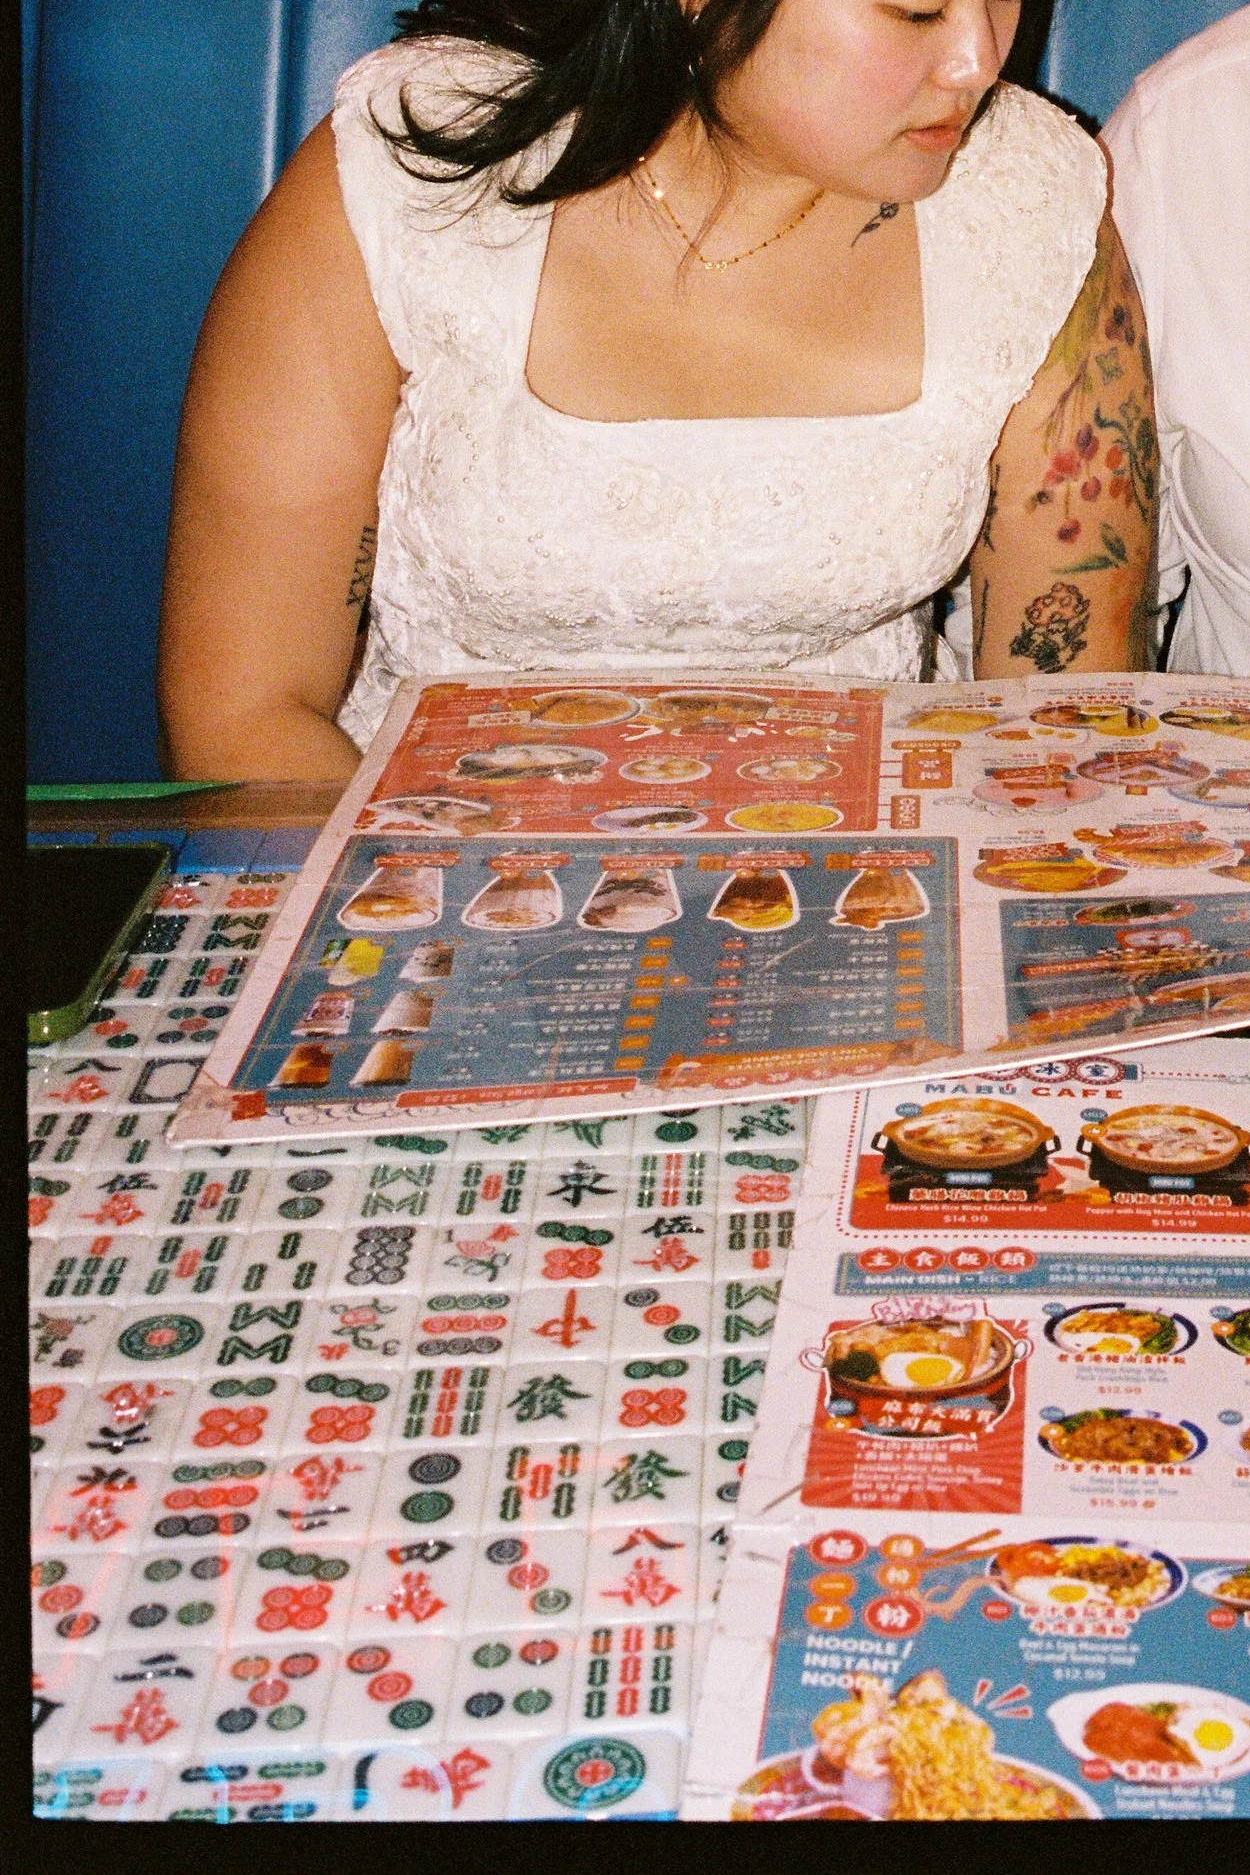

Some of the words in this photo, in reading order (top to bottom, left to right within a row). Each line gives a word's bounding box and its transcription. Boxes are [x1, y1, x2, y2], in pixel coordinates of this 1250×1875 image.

[1031, 1086, 1123, 1100] CAFE
[546, 1160, 617, 1208] 東
[944, 1214, 989, 1224] $14.99
[1151, 1218, 1198, 1228] $14.99
[864, 1274, 919, 1285] MAIN
[922, 1274, 961, 1285] DISH
[979, 1274, 1018, 1285] RICE
[806, 1634, 899, 1655] NOODLE
[803, 1651, 902, 1674] INSTANT
